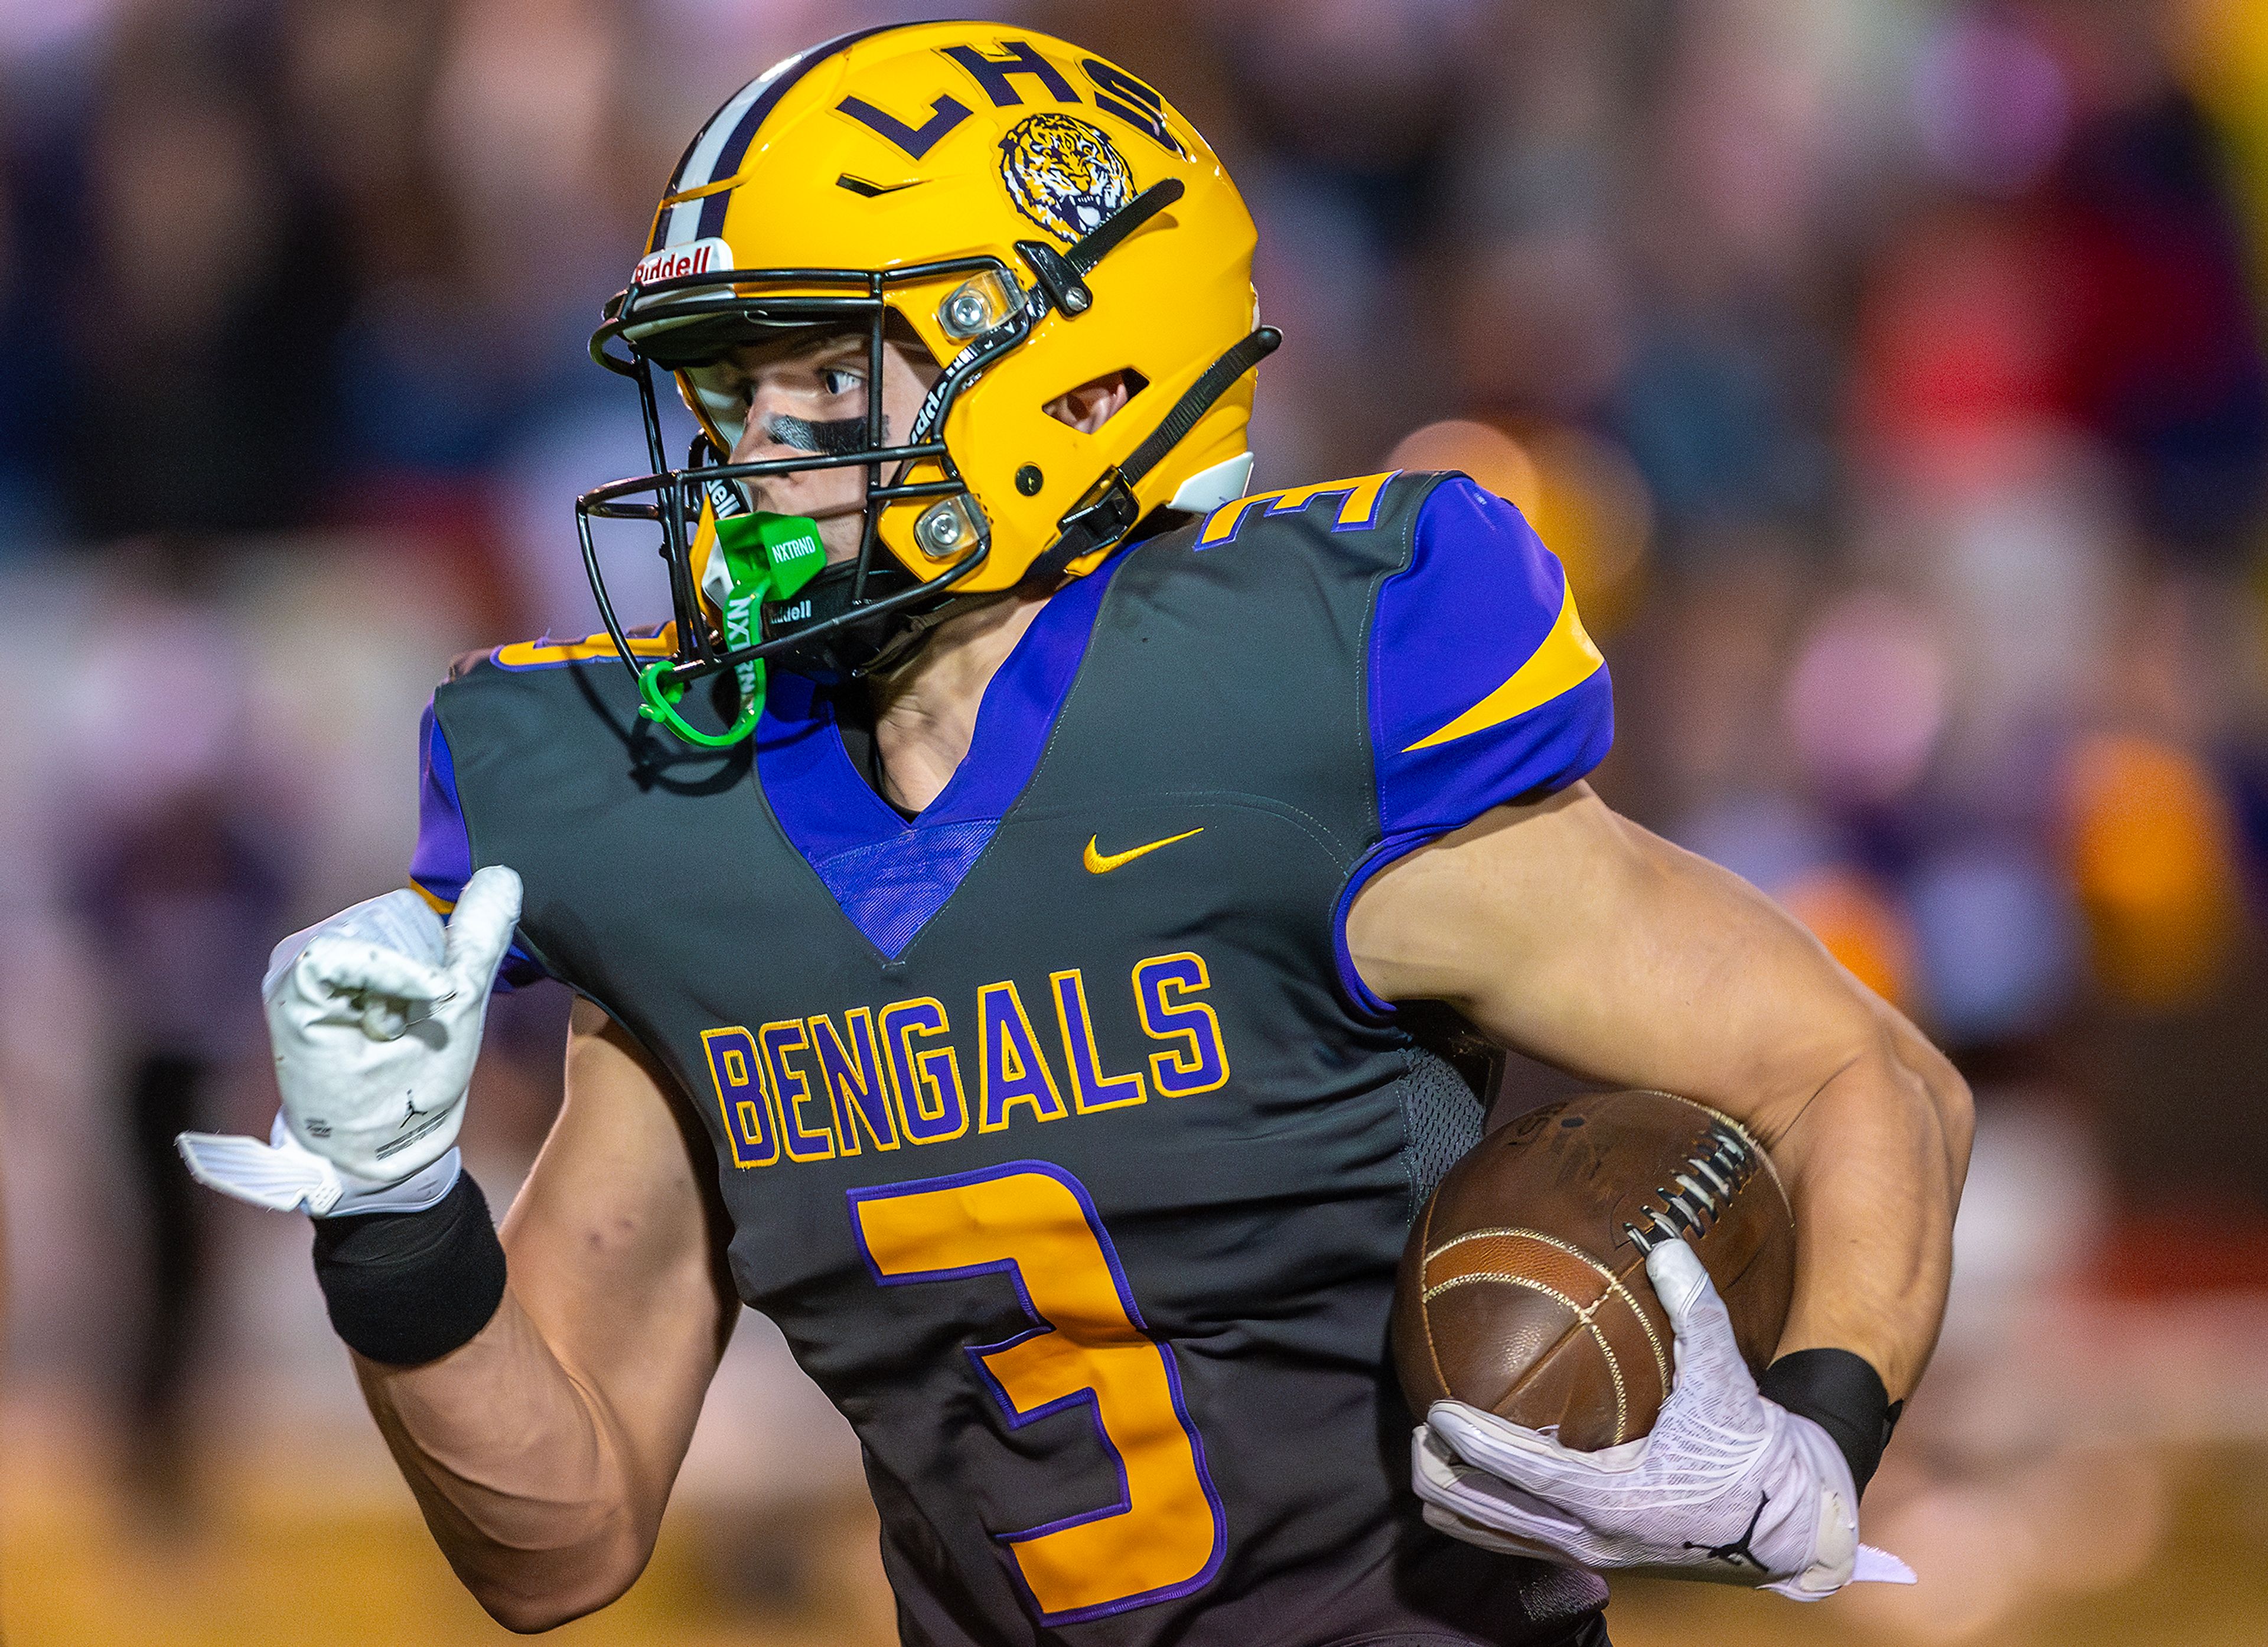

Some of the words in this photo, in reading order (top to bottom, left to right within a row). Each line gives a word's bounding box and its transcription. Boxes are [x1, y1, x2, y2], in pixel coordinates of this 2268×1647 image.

[835, 41, 1179, 161] LHS
[635, 246, 711, 282] Riddell
[772, 536, 816, 564] NXTRND
[700, 951, 1230, 1169] BENGALS
[847, 1159, 1227, 1626] 3
